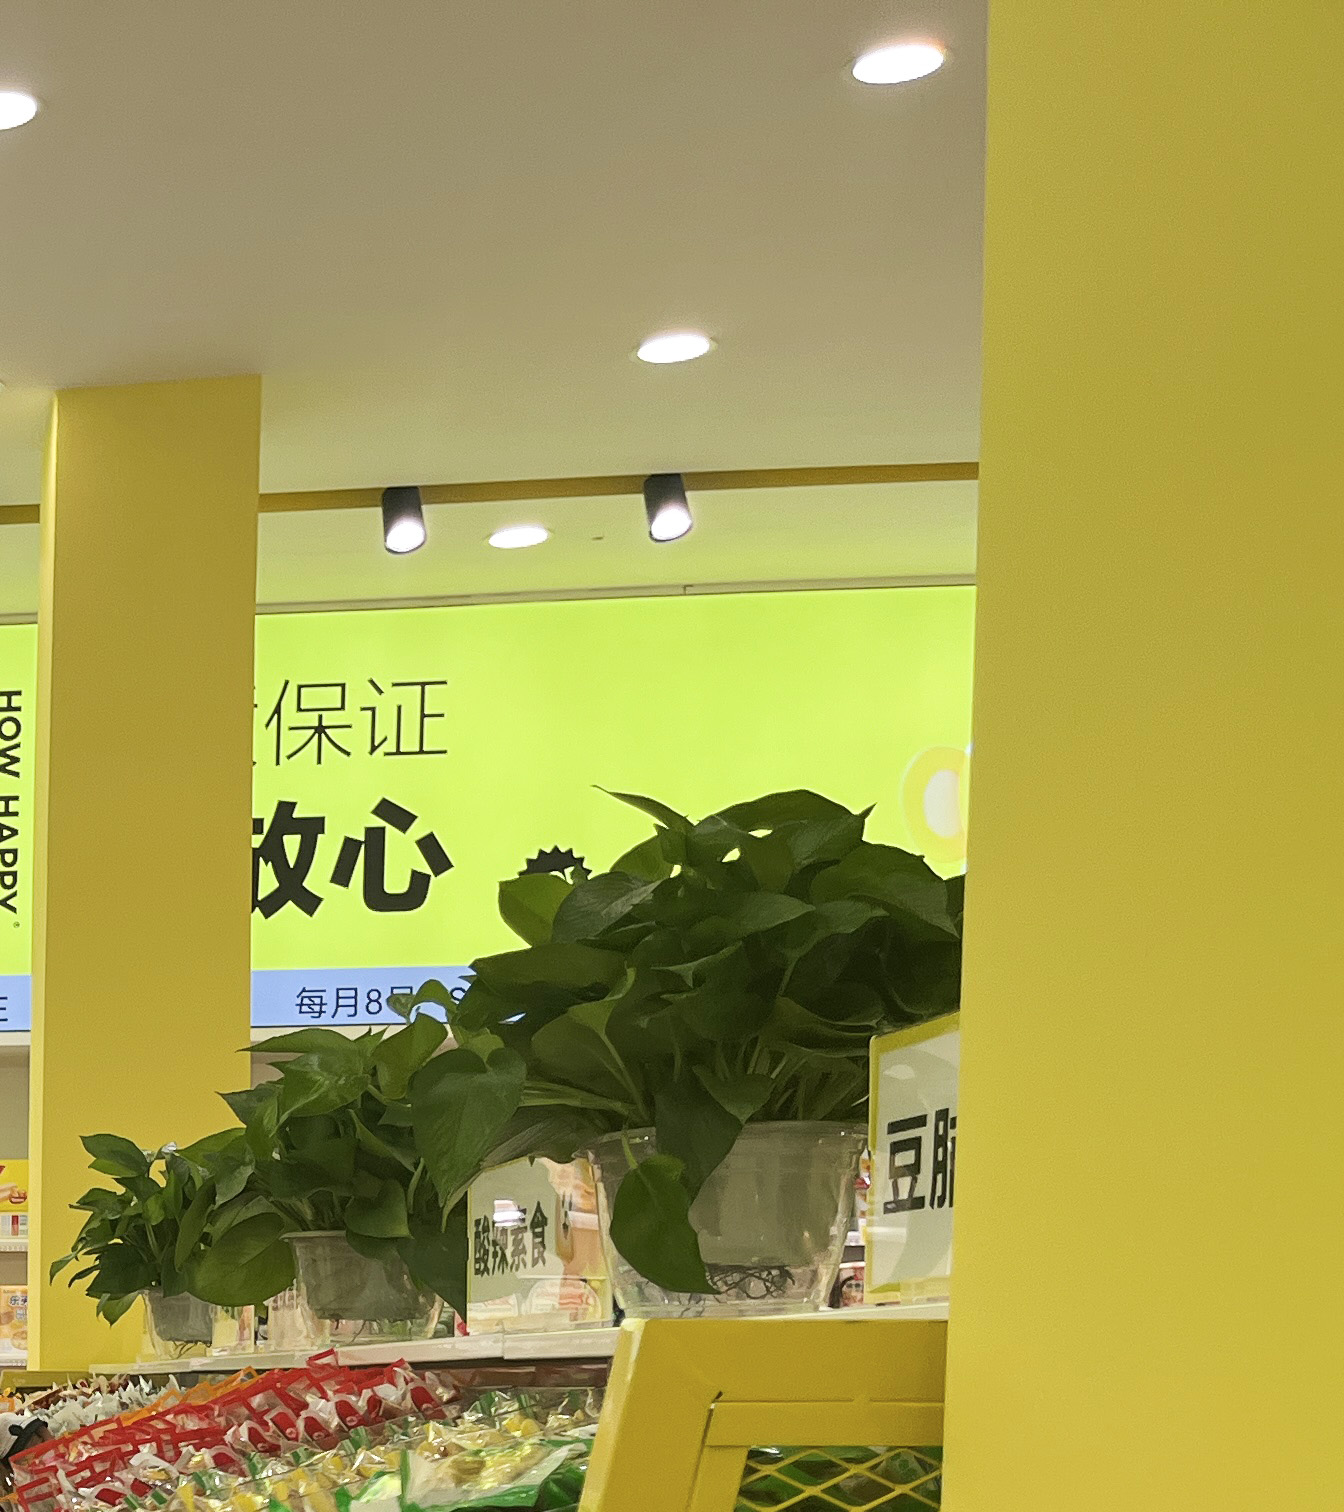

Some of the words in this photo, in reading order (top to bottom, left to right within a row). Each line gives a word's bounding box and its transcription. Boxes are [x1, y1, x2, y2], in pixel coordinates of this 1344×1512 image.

[252, 676, 451, 770] 保证
[473, 1200, 549, 1278] 酸辣素食
